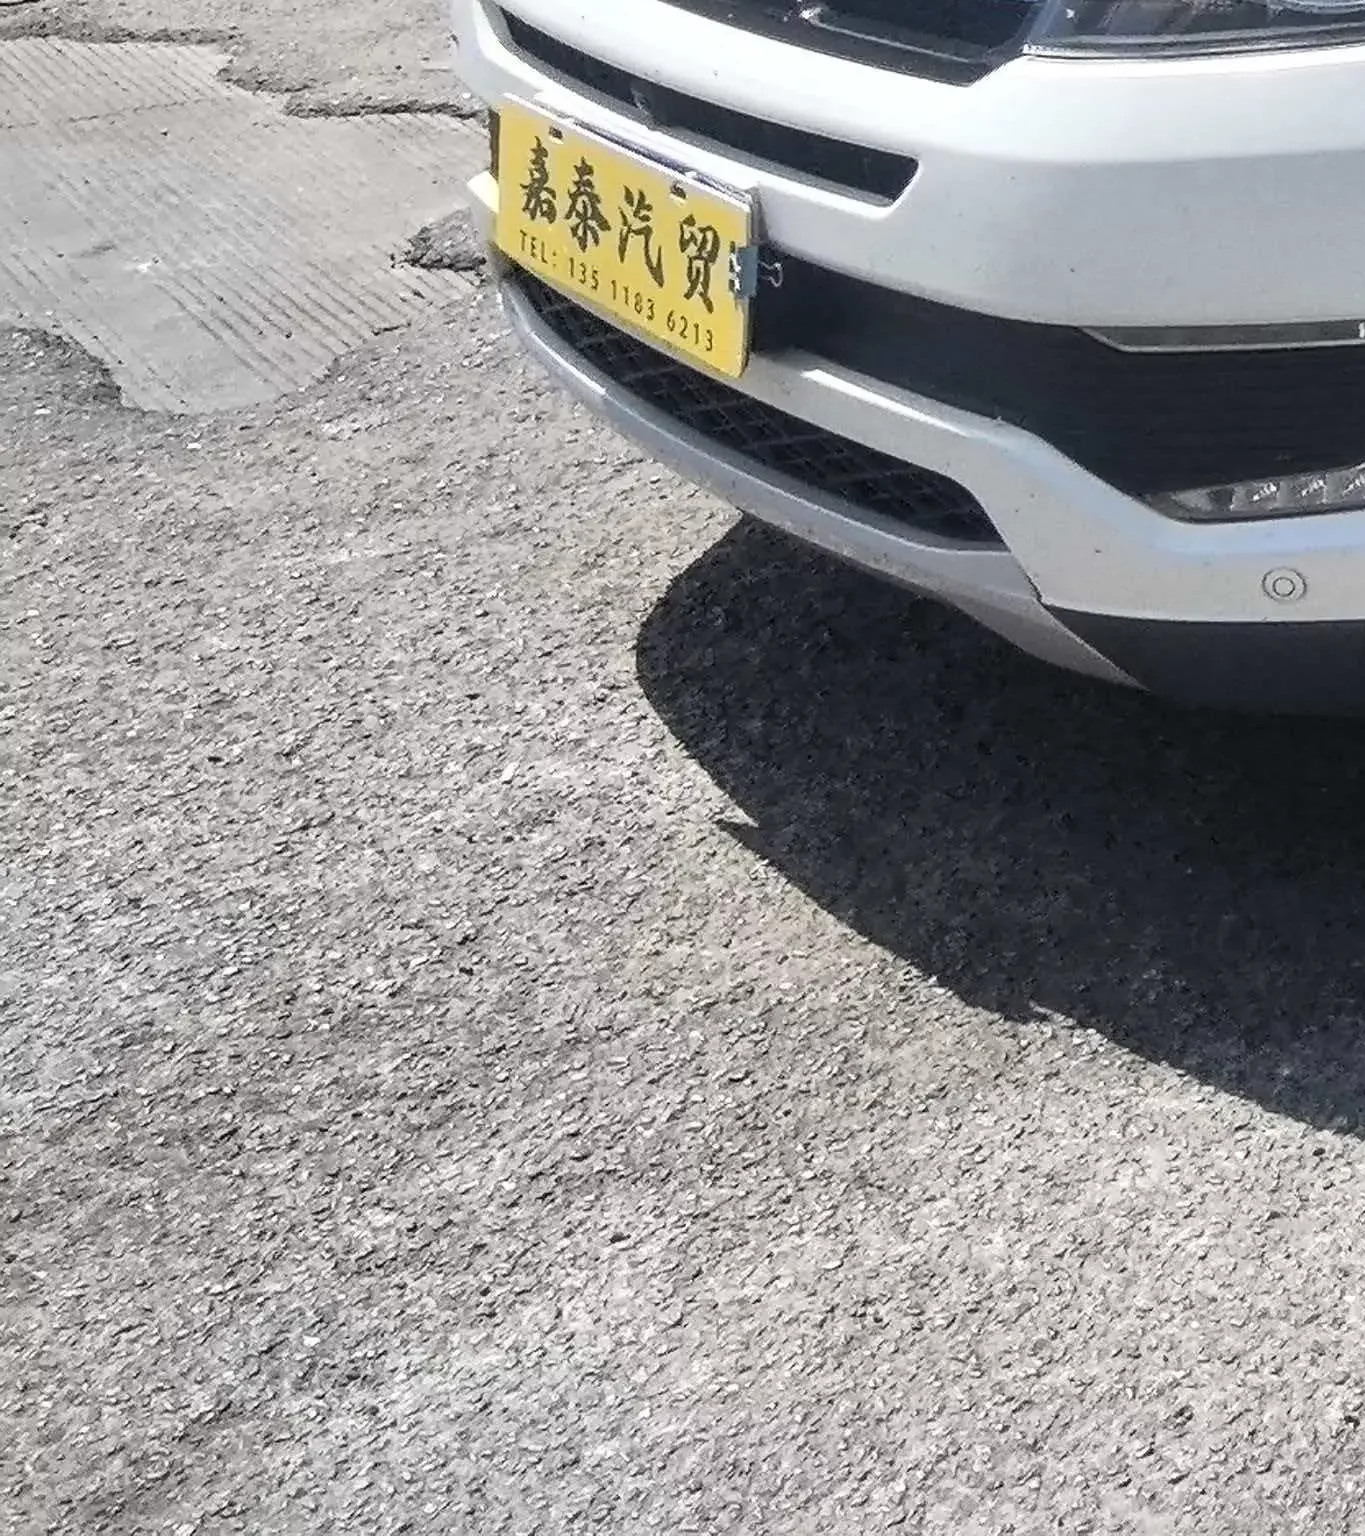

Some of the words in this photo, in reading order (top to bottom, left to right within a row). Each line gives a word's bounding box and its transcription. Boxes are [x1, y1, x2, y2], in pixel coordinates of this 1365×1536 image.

[519, 135, 722, 315] 嘉泰汽贸
[568, 256, 600, 292] 135
[666, 309, 714, 353] 6213
